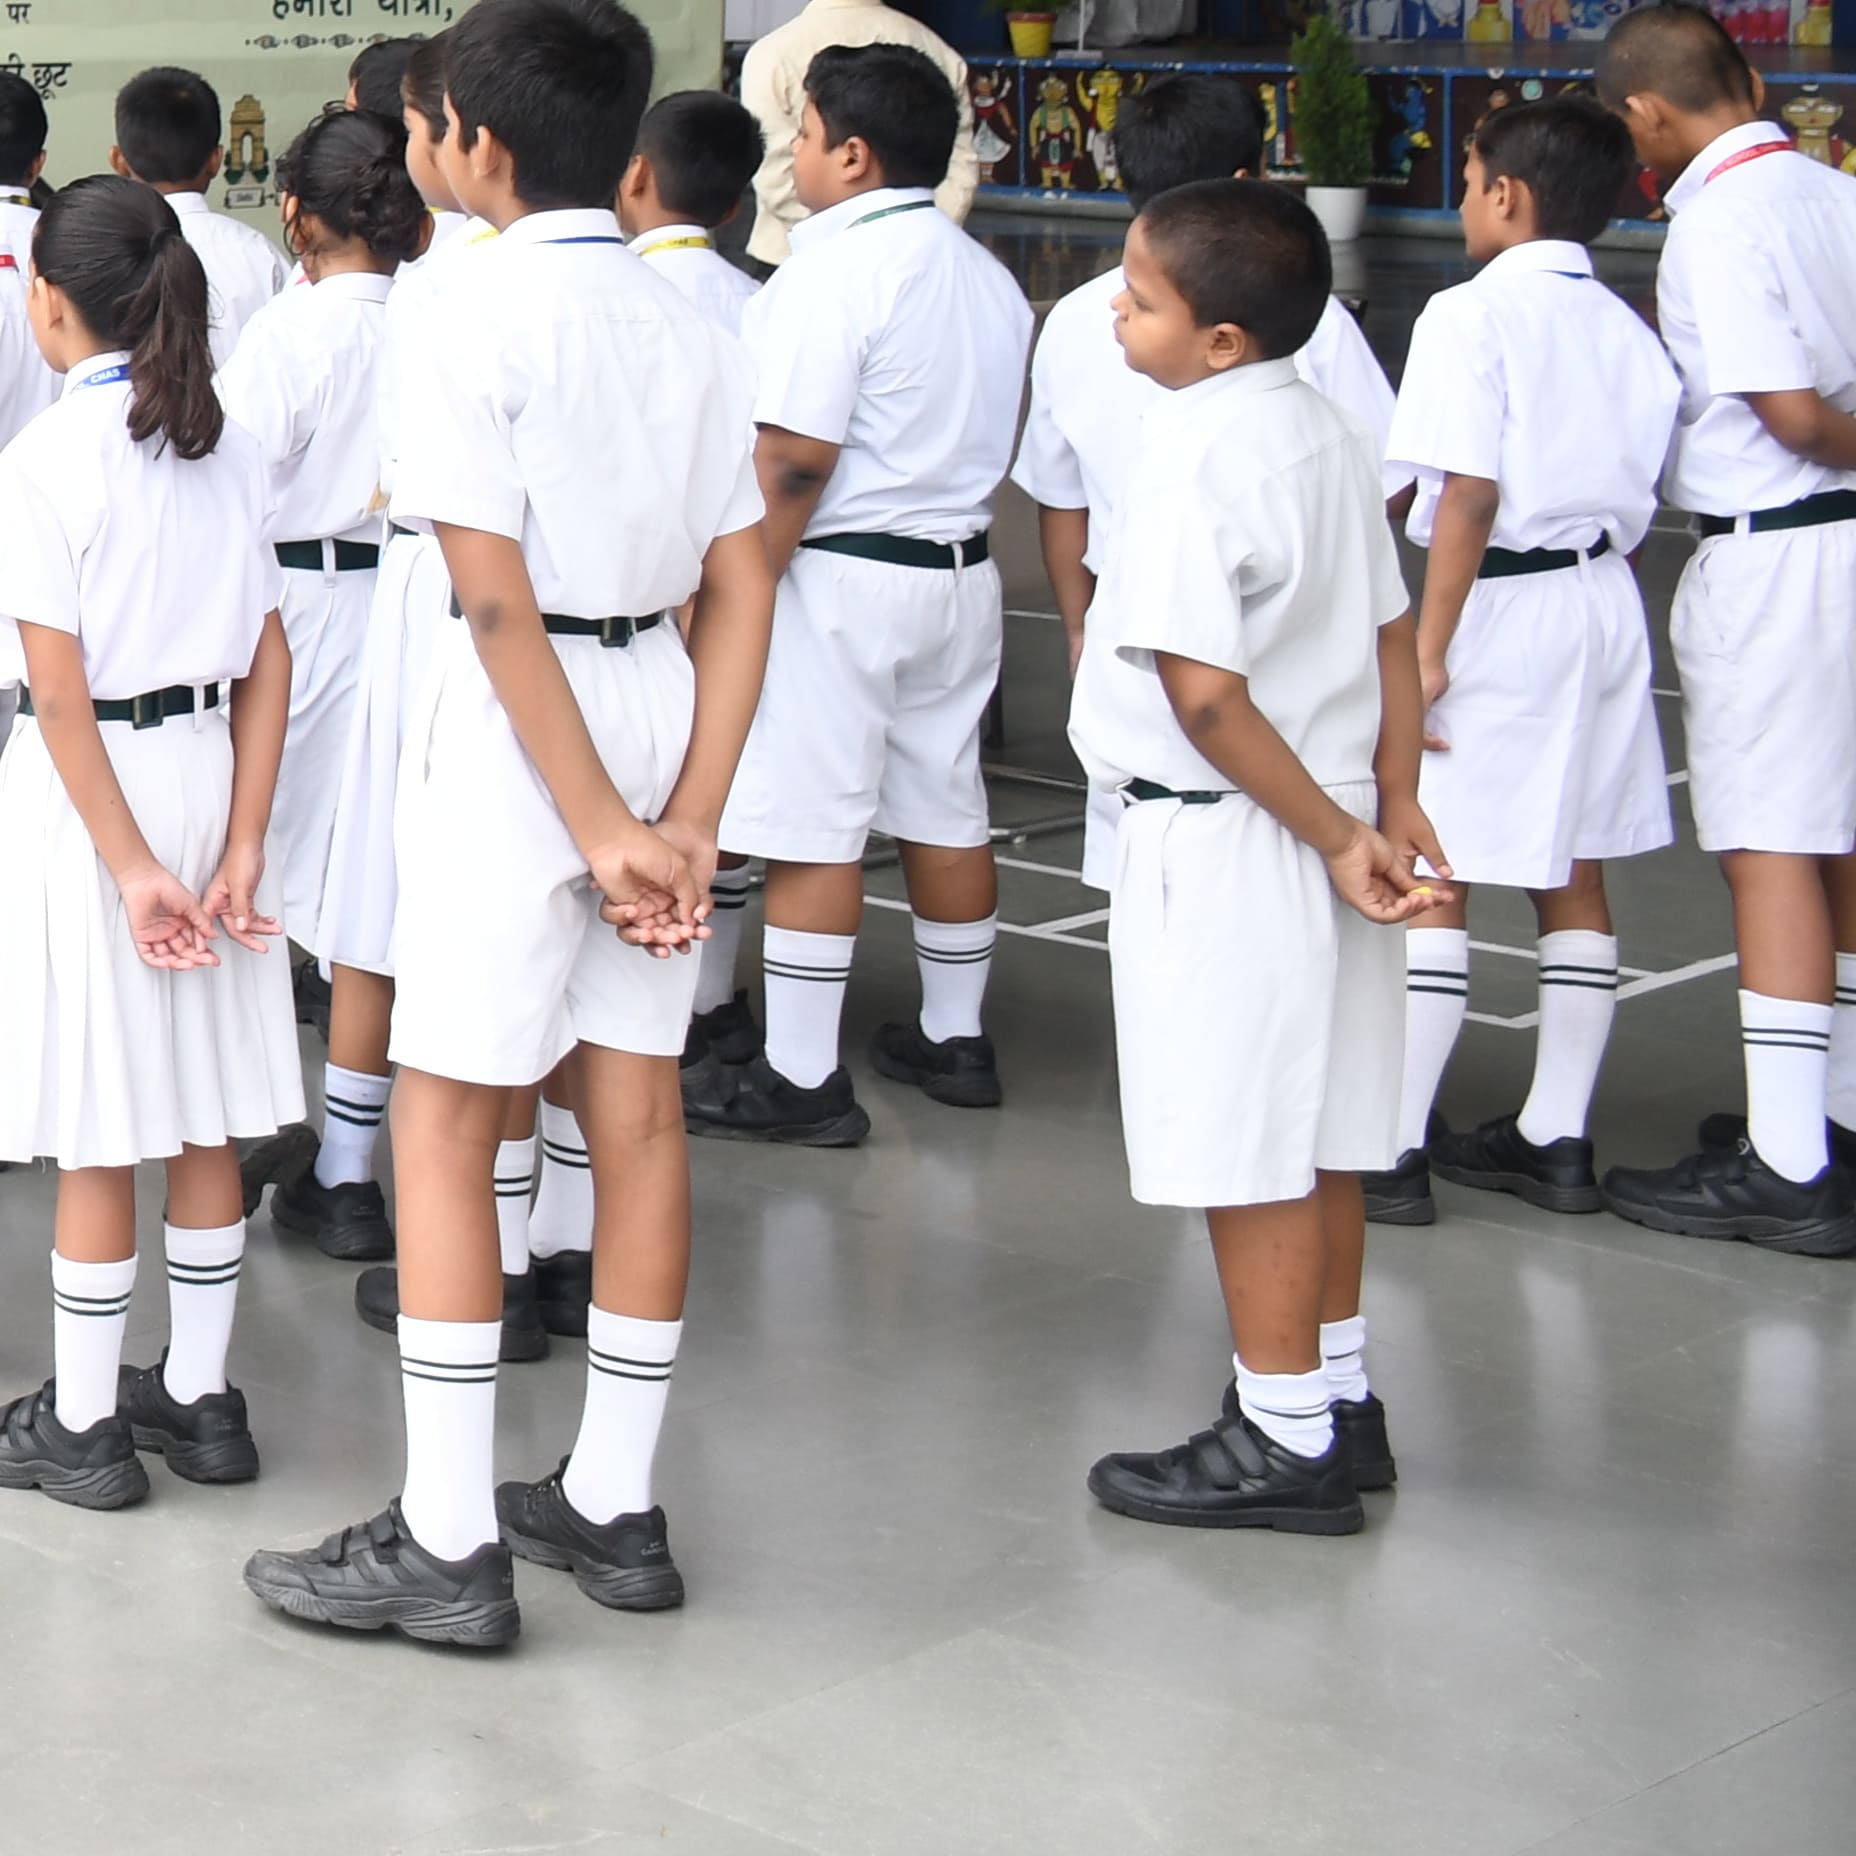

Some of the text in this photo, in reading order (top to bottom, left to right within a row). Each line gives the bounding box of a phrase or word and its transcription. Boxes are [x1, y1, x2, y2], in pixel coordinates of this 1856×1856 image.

[6, 3, 32, 24] पर
[32, 62, 72, 99] छूट
[89, 367, 121, 384] CHAS
